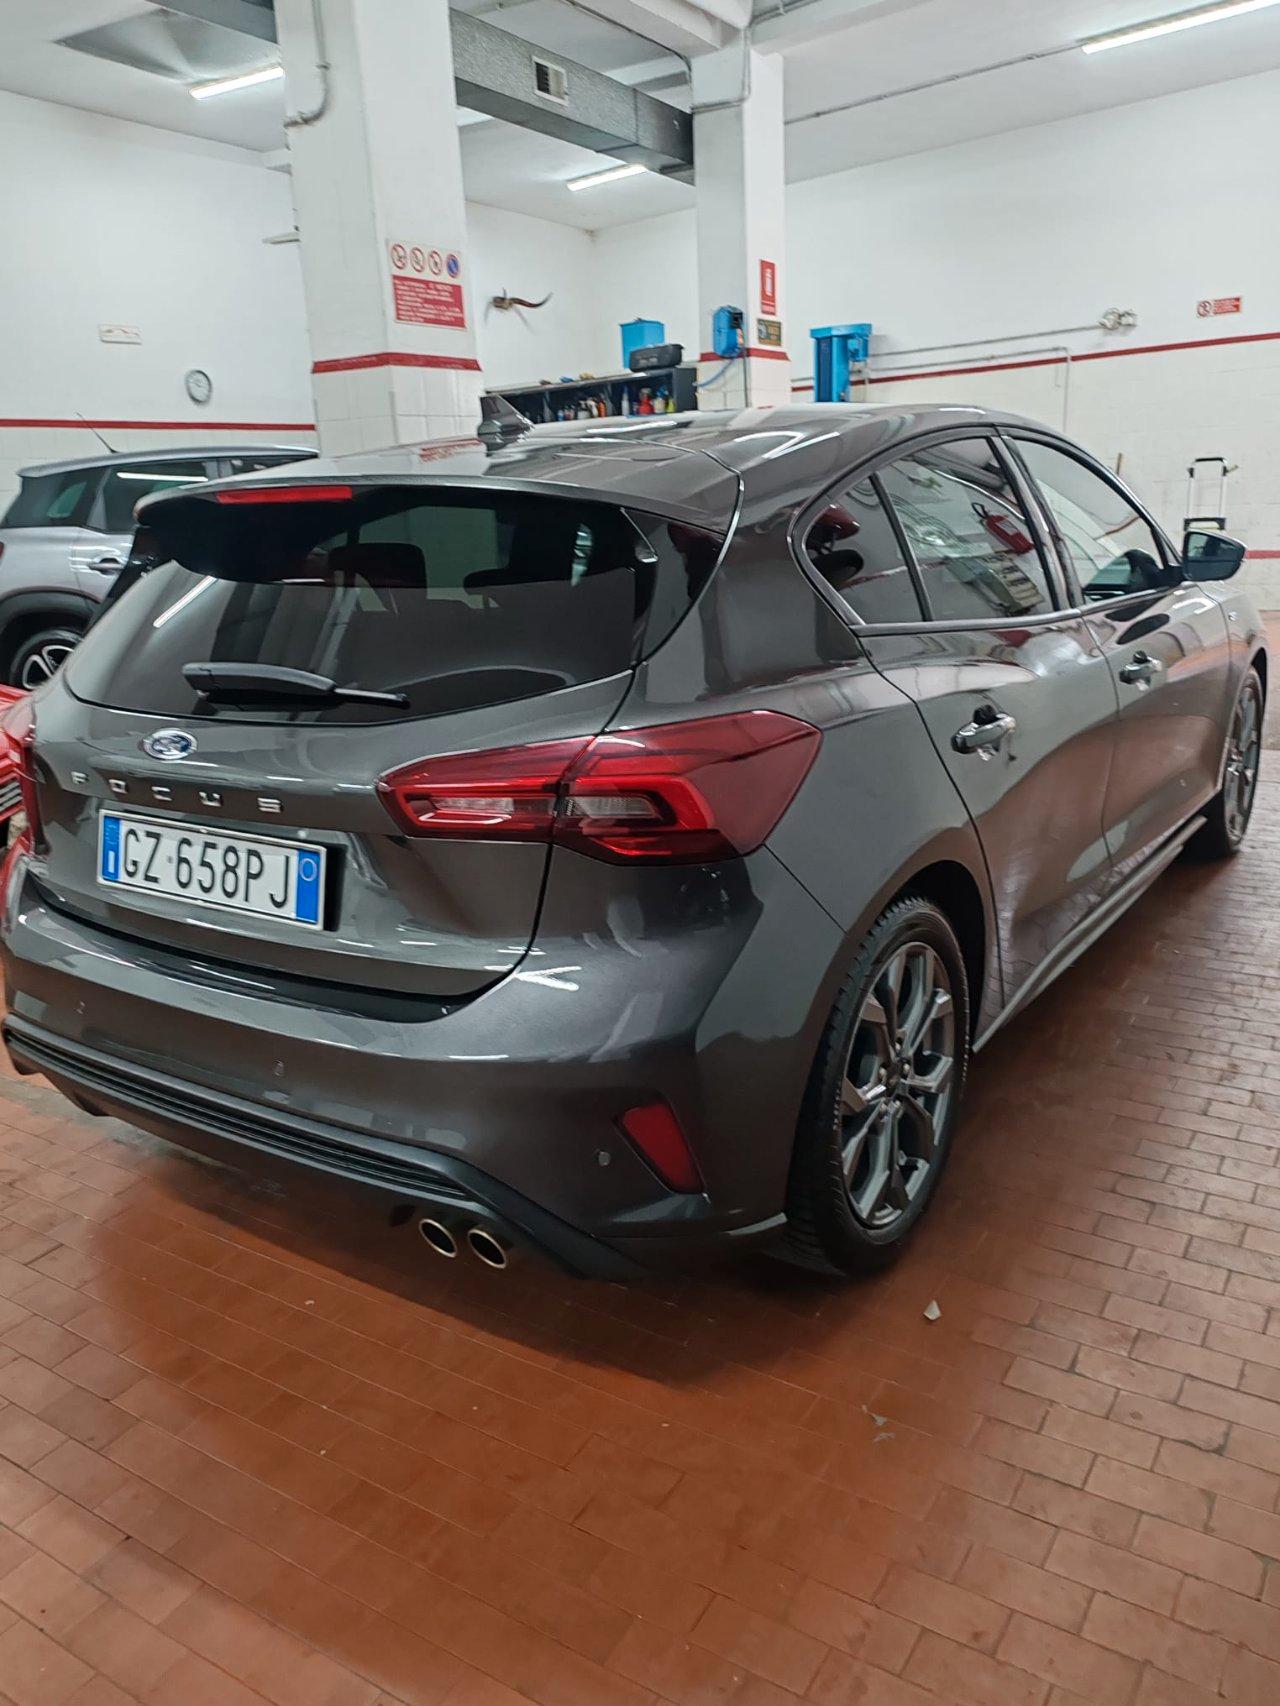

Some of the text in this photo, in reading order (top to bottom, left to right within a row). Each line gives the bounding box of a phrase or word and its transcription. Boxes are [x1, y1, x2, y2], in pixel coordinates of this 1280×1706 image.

[71, 771, 283, 814] FOCUS
[123, 828, 291, 908] GZ 658PJ
